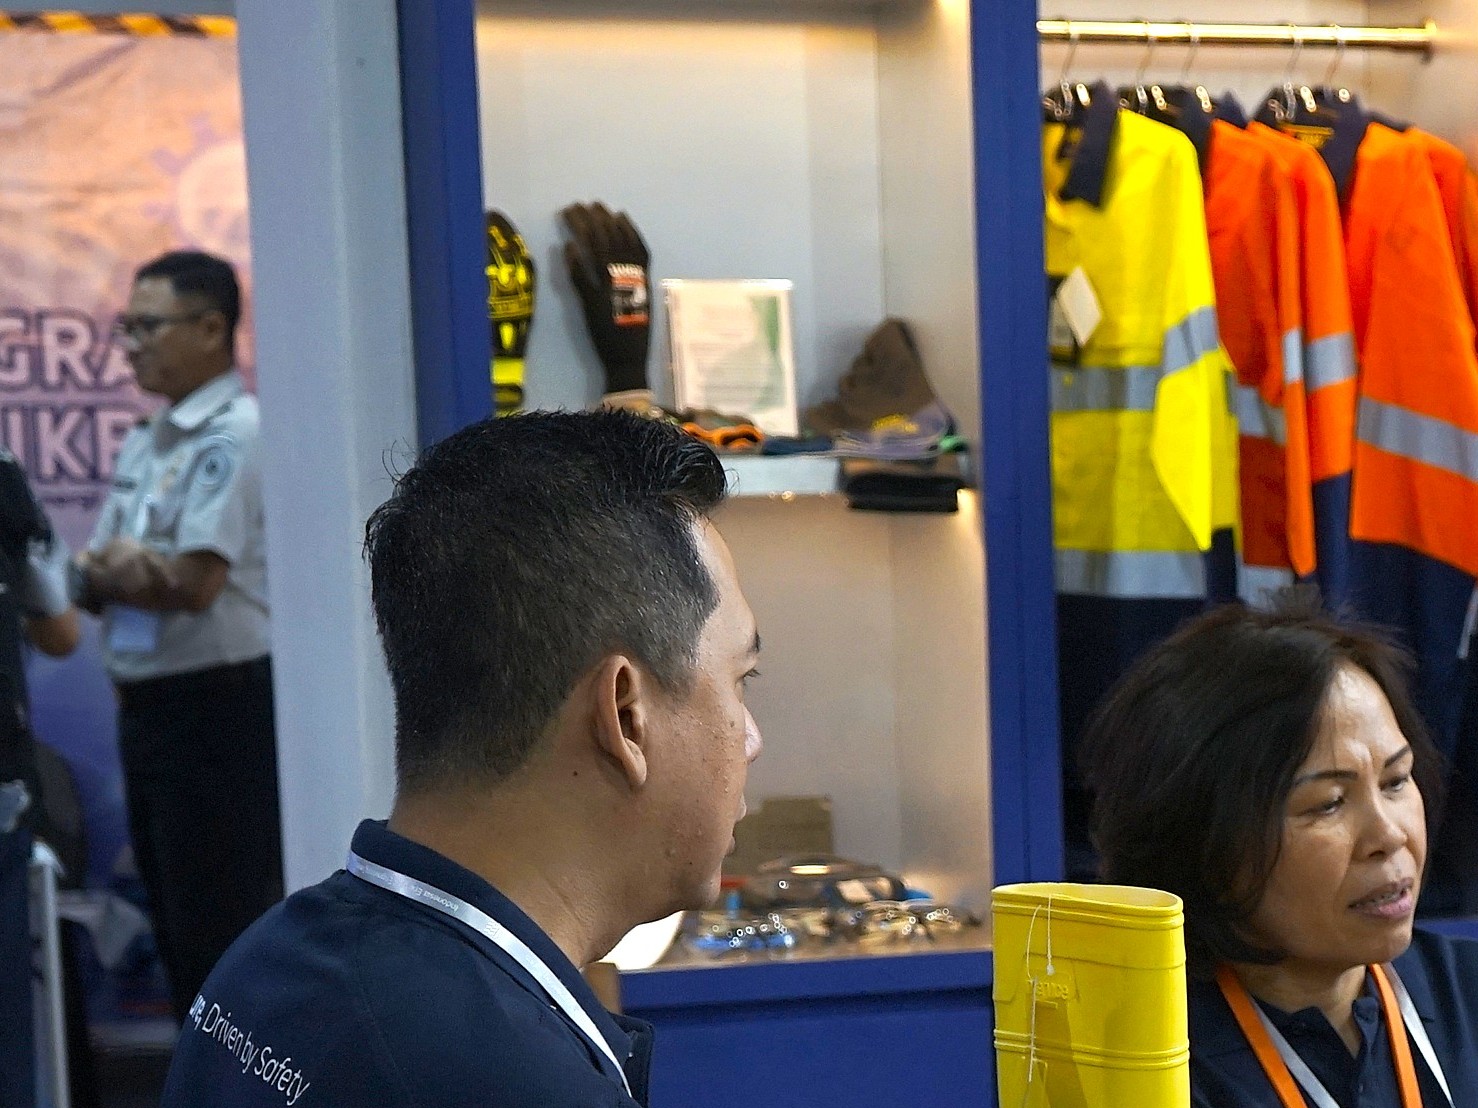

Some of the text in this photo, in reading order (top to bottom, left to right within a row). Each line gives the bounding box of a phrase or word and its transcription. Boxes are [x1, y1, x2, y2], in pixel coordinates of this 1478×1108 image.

[202, 1002, 244, 1057] Driven
[240, 1031, 260, 1075] by
[254, 1046, 311, 1106] Safety
